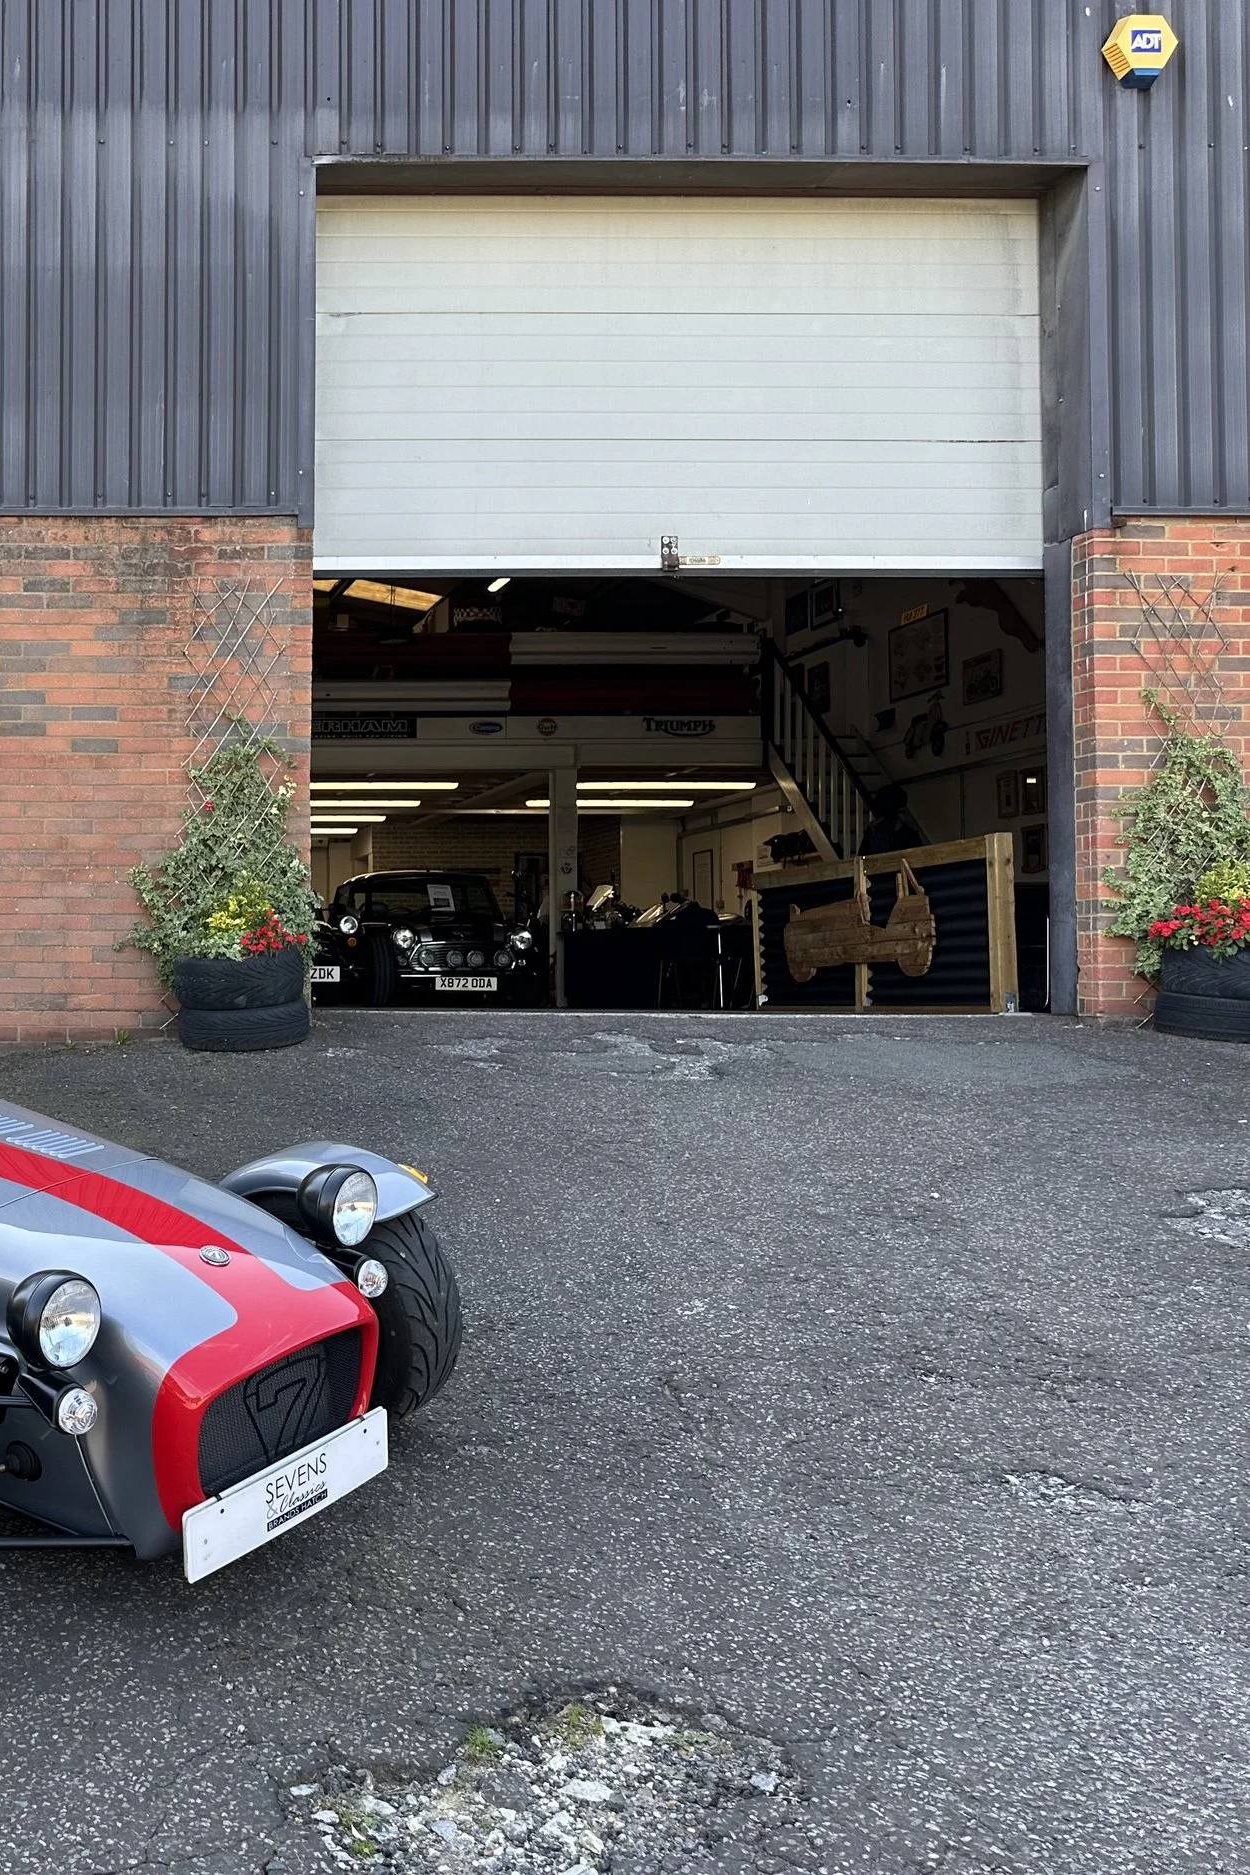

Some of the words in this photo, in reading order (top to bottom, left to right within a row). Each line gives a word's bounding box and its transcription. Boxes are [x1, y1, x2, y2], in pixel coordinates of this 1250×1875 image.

[1131, 32, 1161, 49] ADT
[643, 717, 716, 737] TRIUMPH
[311, 968, 335, 980] ZDK
[440, 978, 468, 988] X872
[265, 1452, 327, 1504] SEVENS
[279, 1481, 326, 1513] Classics
[268, 1508, 300, 1530] BRANDS
[301, 1491, 327, 1512] HATCH
